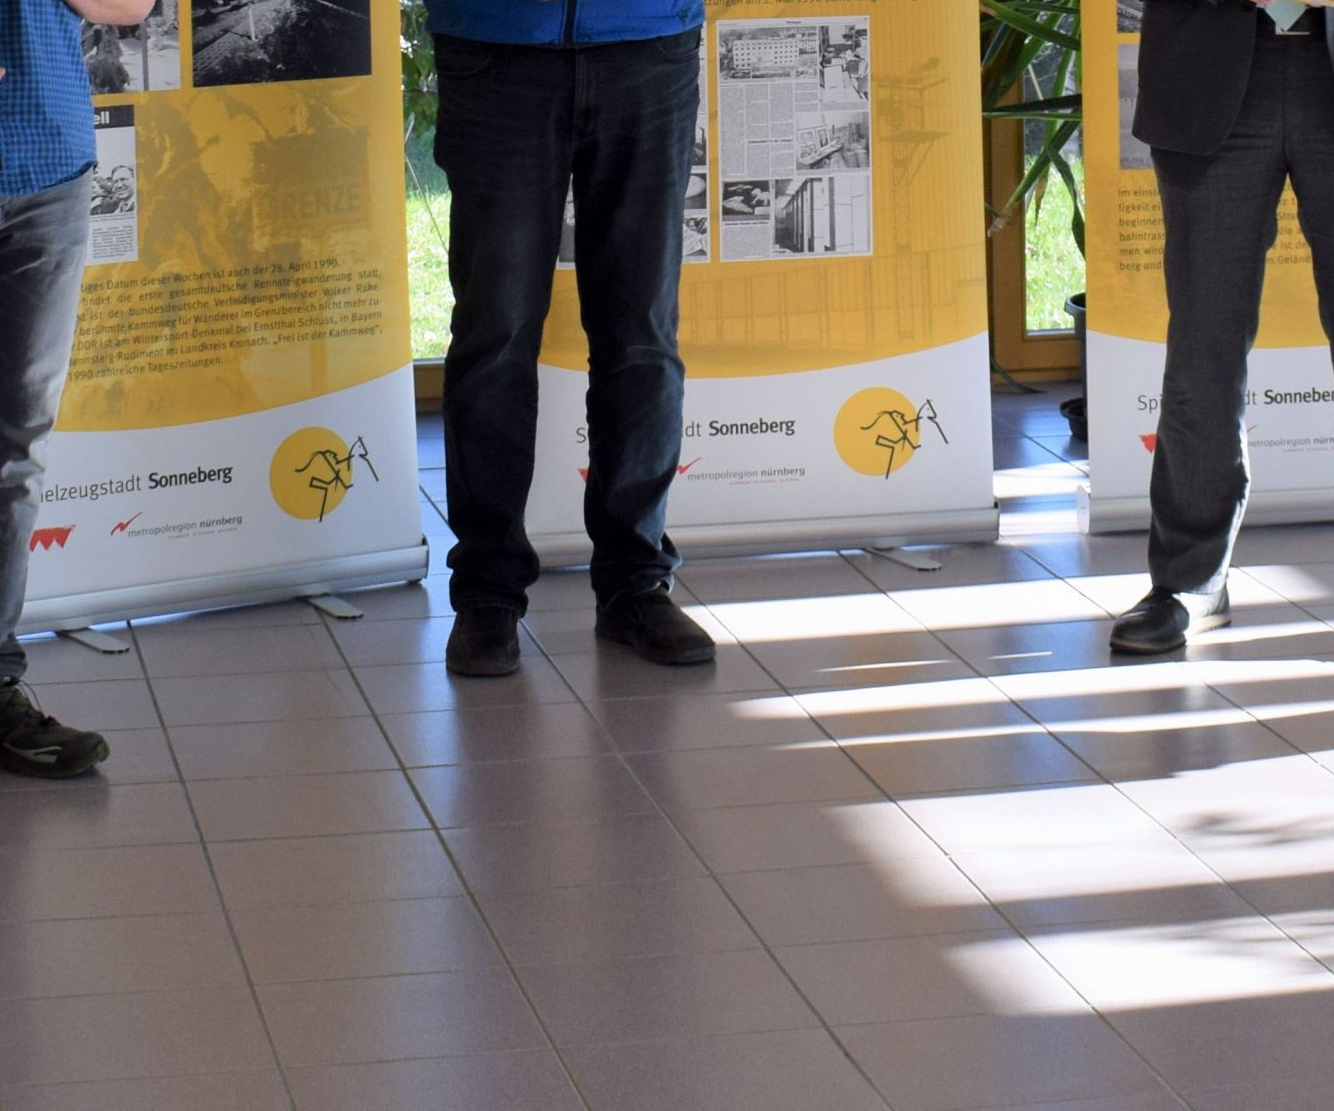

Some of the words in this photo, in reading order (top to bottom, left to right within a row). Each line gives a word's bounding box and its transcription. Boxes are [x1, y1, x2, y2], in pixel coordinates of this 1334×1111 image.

[707, 416, 796, 437] Sonneberg
[41, 474, 142, 503] elzeugstadt
[147, 465, 234, 490] Sonneberg
